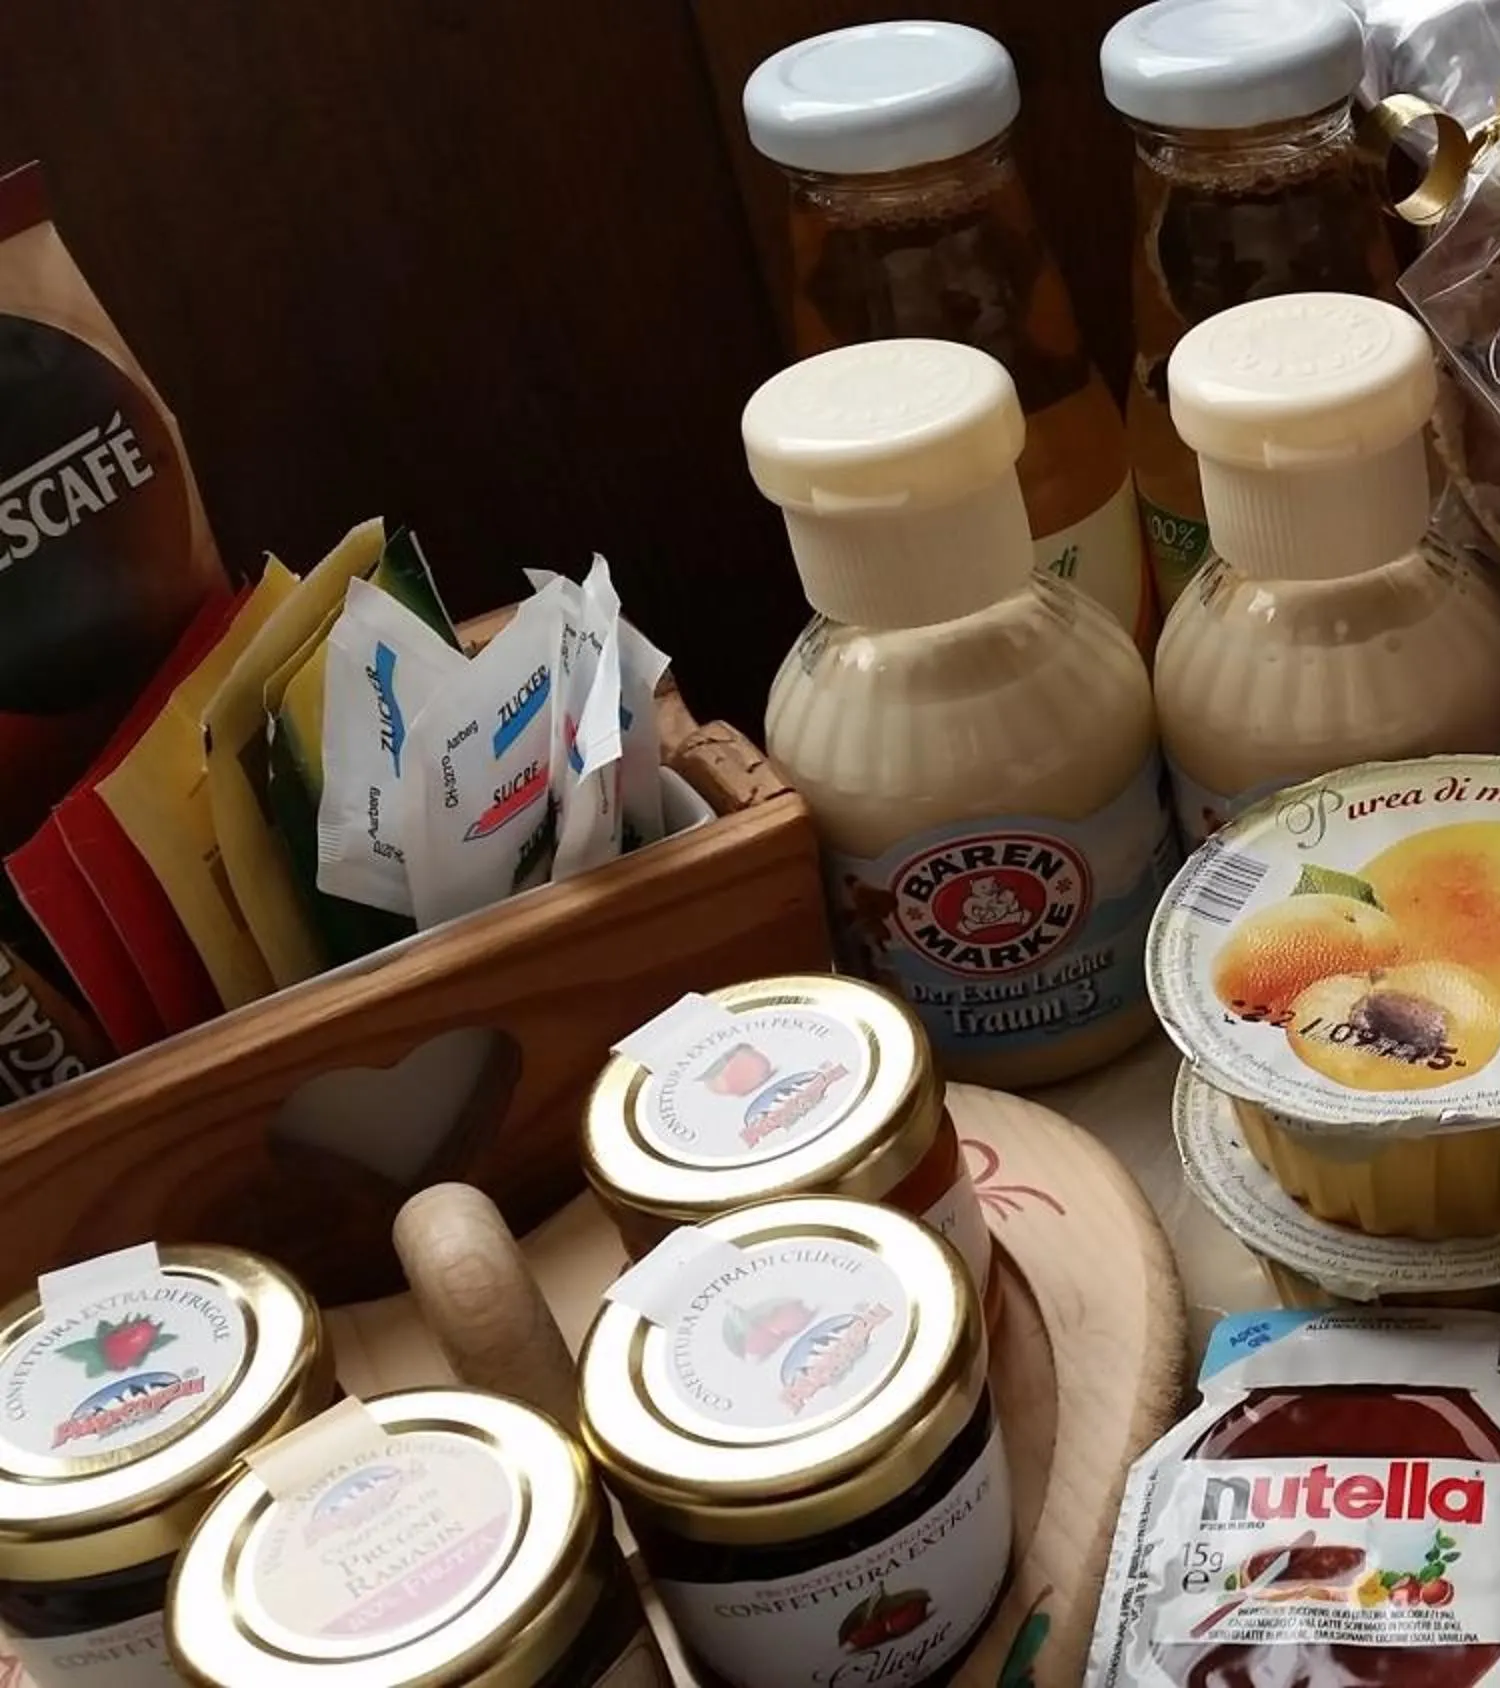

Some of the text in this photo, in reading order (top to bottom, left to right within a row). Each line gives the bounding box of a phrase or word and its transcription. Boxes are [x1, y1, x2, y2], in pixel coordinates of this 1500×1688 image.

[0, 410, 154, 572] SCAFÉ
[1152, 515, 1196, 549] 00%
[497, 664, 549, 728] ZUCKER
[493, 761, 539, 808] SUCRE
[1276, 784, 1422, 848] Purea
[1434, 777, 1469, 802] di
[903, 843, 1066, 902] BÄREN
[915, 903, 1075, 970] MARKE
[911, 950, 1114, 1004] Der Extra Leichte
[950, 997, 1063, 1036] Traum
[692, 1267, 749, 1313] EXTRA
[1201, 1462, 1486, 1525] nutella
[715, 1559, 900, 1619] CONFETTURA
[906, 1502, 975, 1562] EXTRA
[1181, 1542, 1225, 1573] 15g
